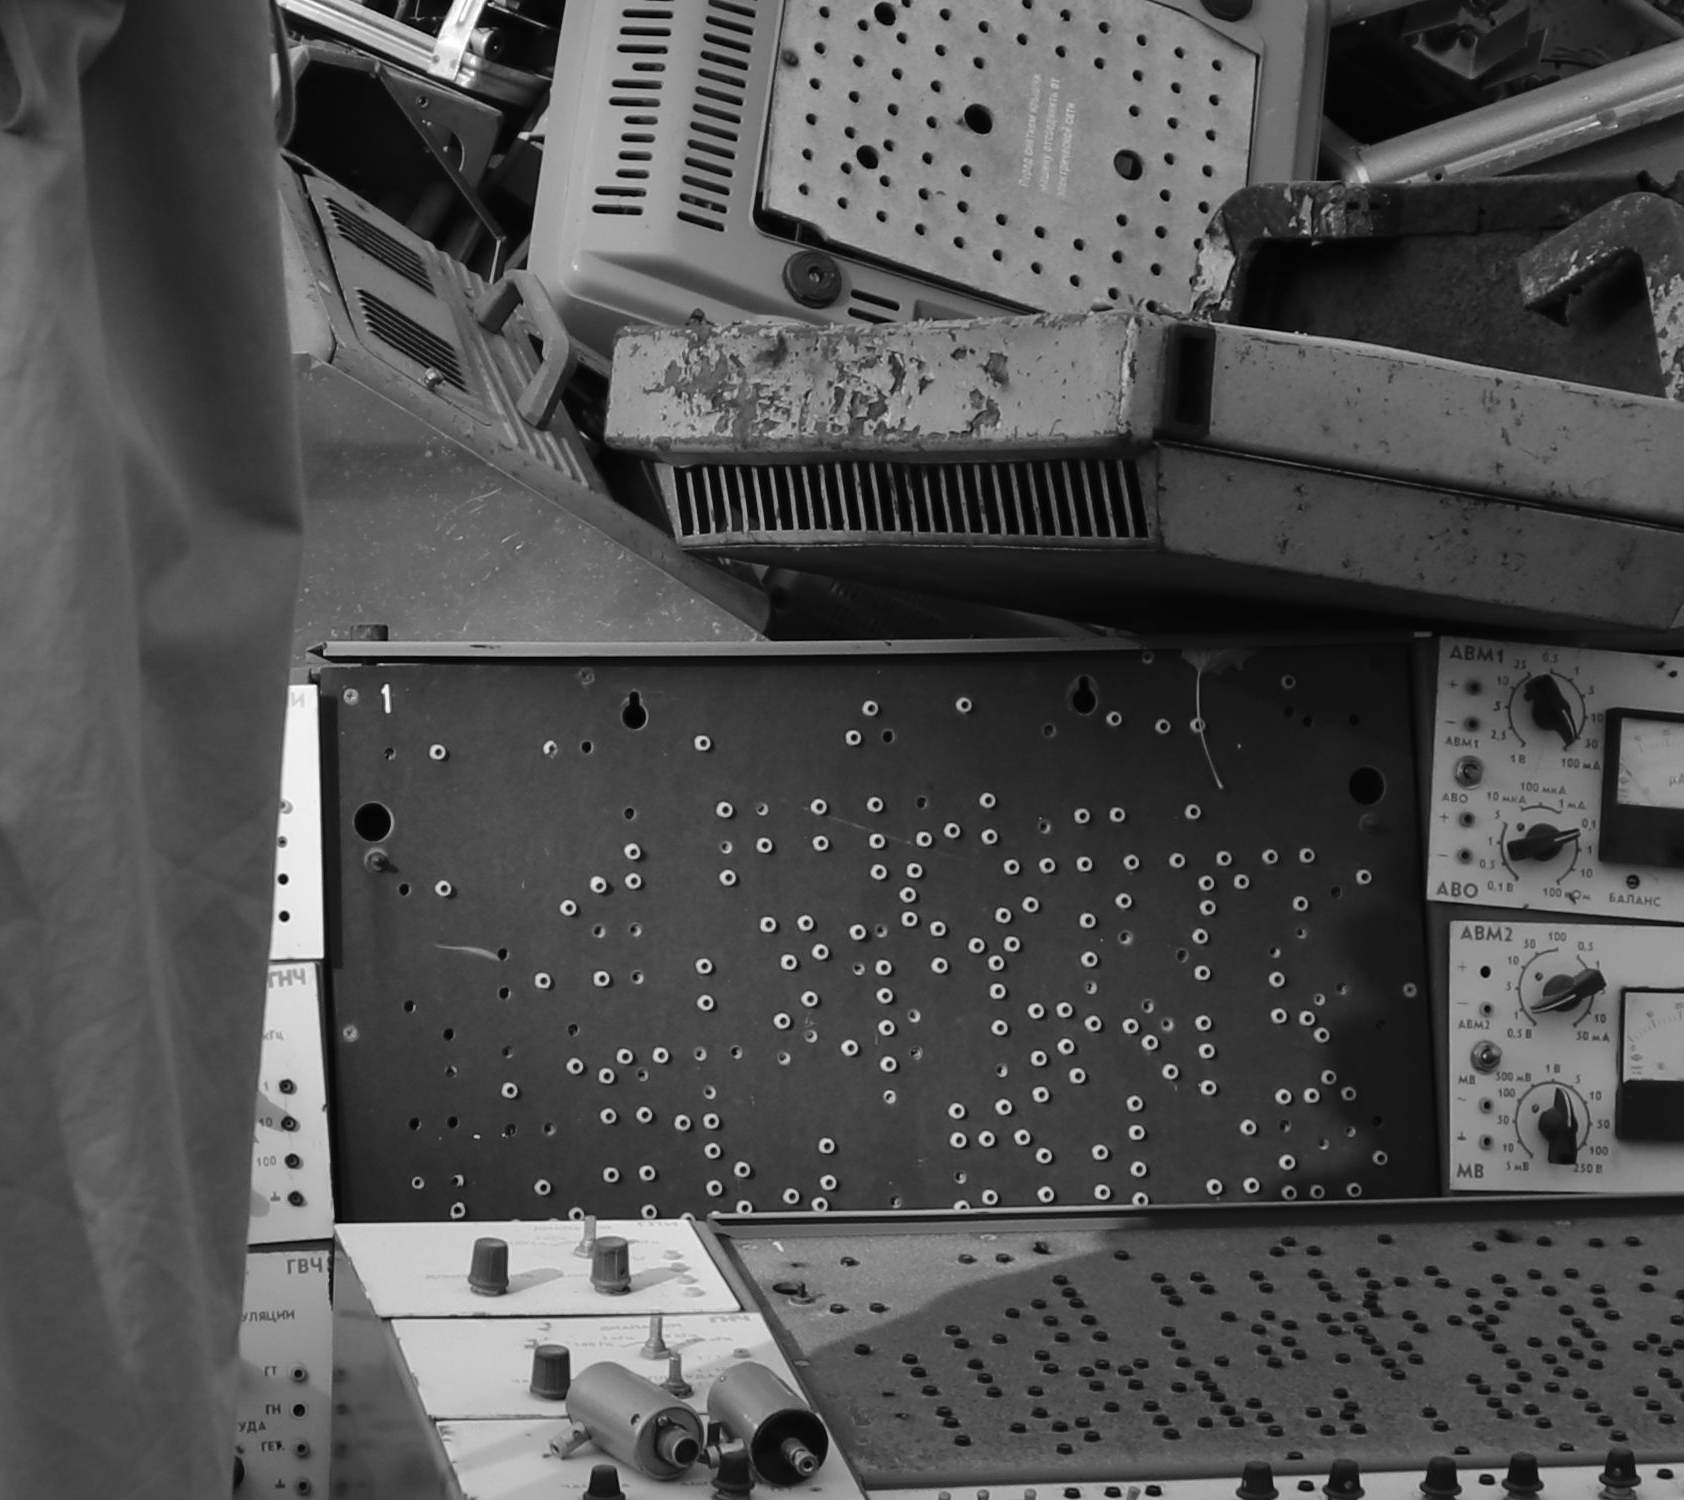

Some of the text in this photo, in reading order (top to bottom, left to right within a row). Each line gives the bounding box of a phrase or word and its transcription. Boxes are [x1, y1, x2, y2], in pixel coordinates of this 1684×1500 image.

[1449, 645, 1505, 664] АВМ1
[380, 683, 393, 715] 1
[1445, 736, 1479, 748] АВМ1
[1561, 758, 1580, 769] 100
[1521, 783, 1567, 794] 100 мкА
[1442, 793, 1469, 803] АВО
[1436, 881, 1479, 899] АВО
[1543, 888, 1562, 898] 100
[1608, 893, 1661, 907] БАЛАНС
[1459, 926, 1514, 942] АВМ2
[1548, 932, 1567, 942] 100
[1523, 939, 1536, 949] 50
[267, 967, 307, 989] ГНЧ
[1457, 1020, 1491, 1030] АВМ2
[1458, 1074, 1476, 1085] МВ
[1498, 1089, 1515, 1098] 100
[1590, 1147, 1609, 1156] 100
[256, 1155, 277, 1168] 100
[1456, 1164, 1484, 1179] МВ
[286, 1256, 324, 1275] ГВЧ
[263, 1366, 277, 1377] ГТ
[264, 1403, 282, 1416] ГН
